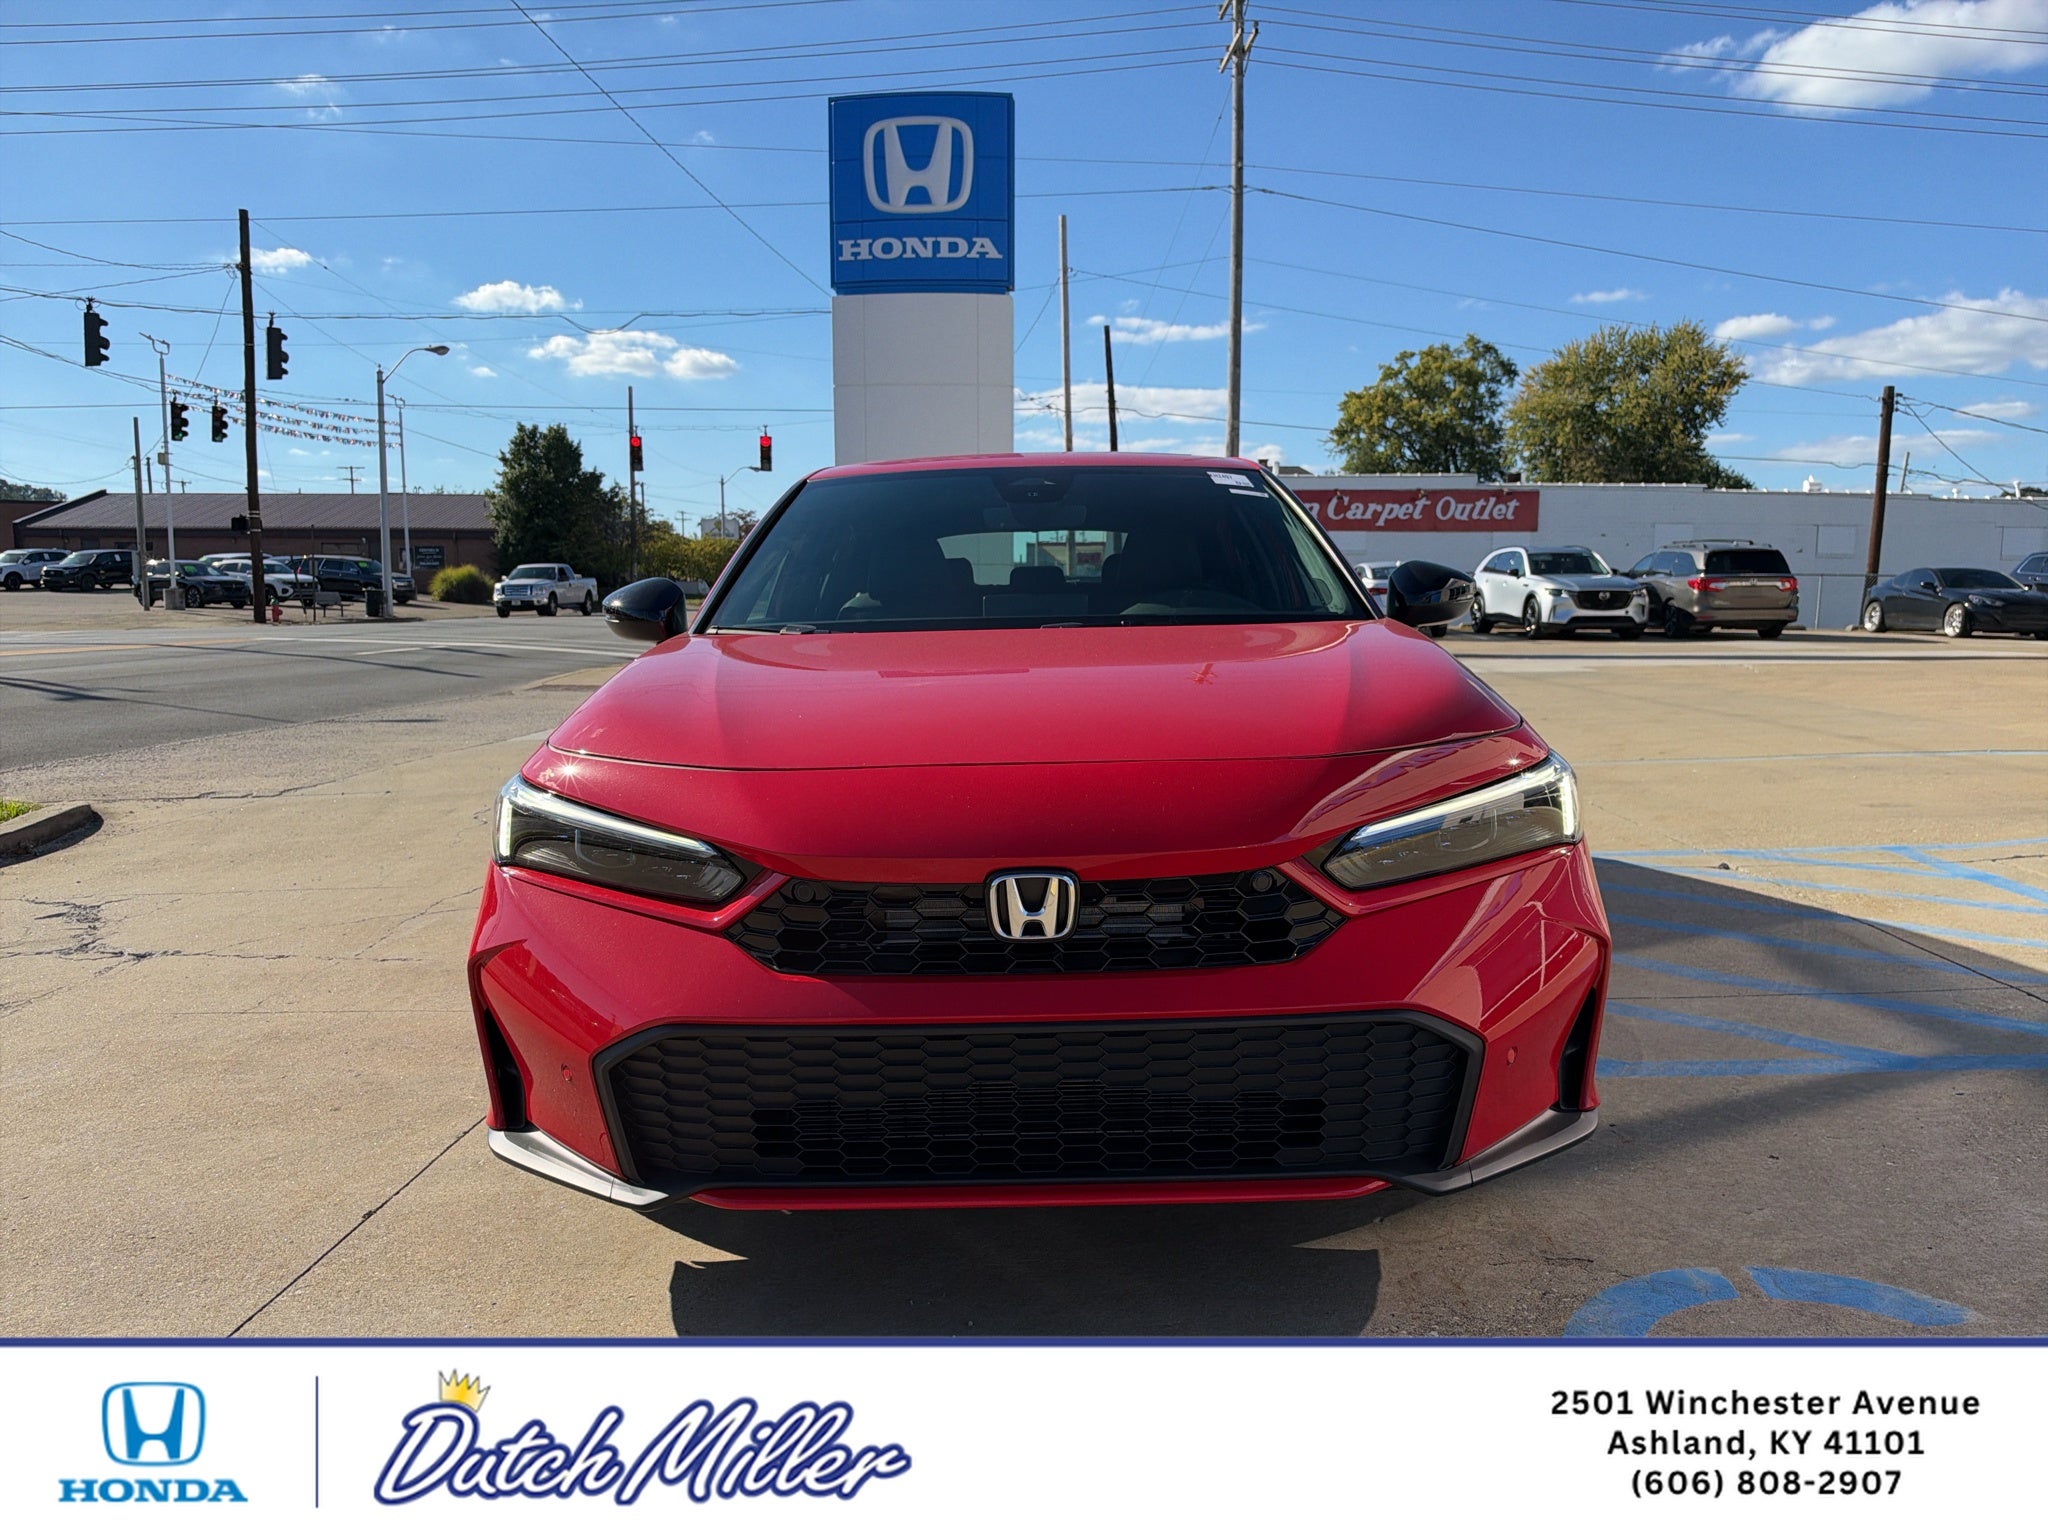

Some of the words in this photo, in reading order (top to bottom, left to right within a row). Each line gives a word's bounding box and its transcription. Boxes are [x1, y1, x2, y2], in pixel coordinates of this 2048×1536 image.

[838, 237, 1003, 261] HONDA
[1327, 496, 1431, 526] Carpet
[1435, 496, 1520, 521] Outlet
